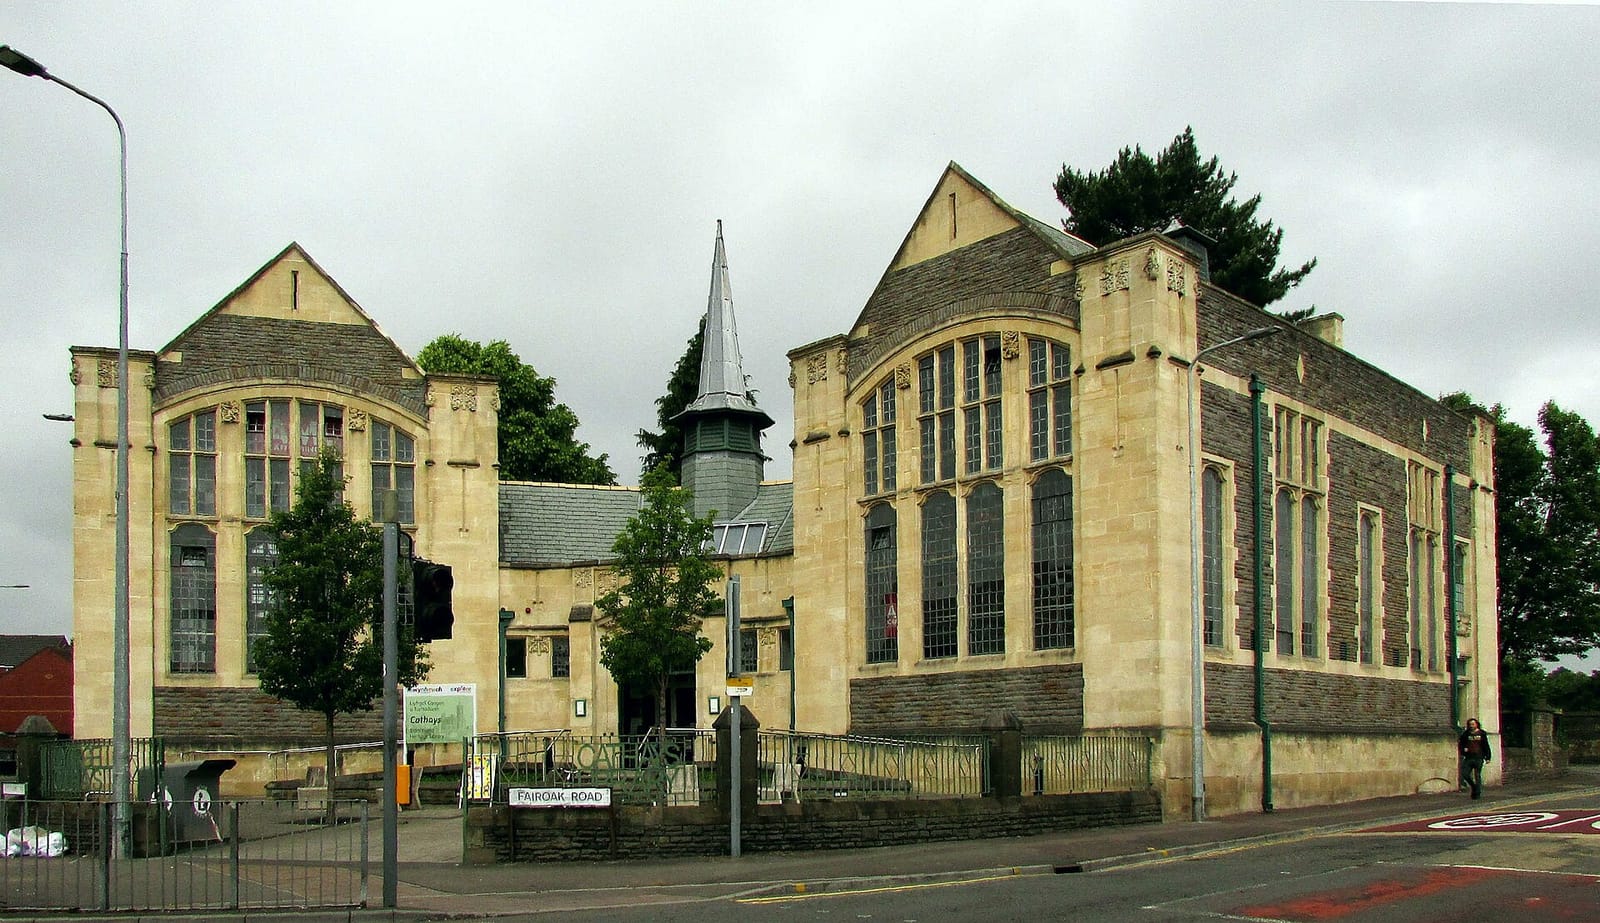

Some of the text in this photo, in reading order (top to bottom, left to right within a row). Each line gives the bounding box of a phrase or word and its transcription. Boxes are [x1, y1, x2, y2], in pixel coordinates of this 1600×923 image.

[410, 715, 441, 725] Cathays
[517, 791, 603, 802] FAIROAK ROAD
